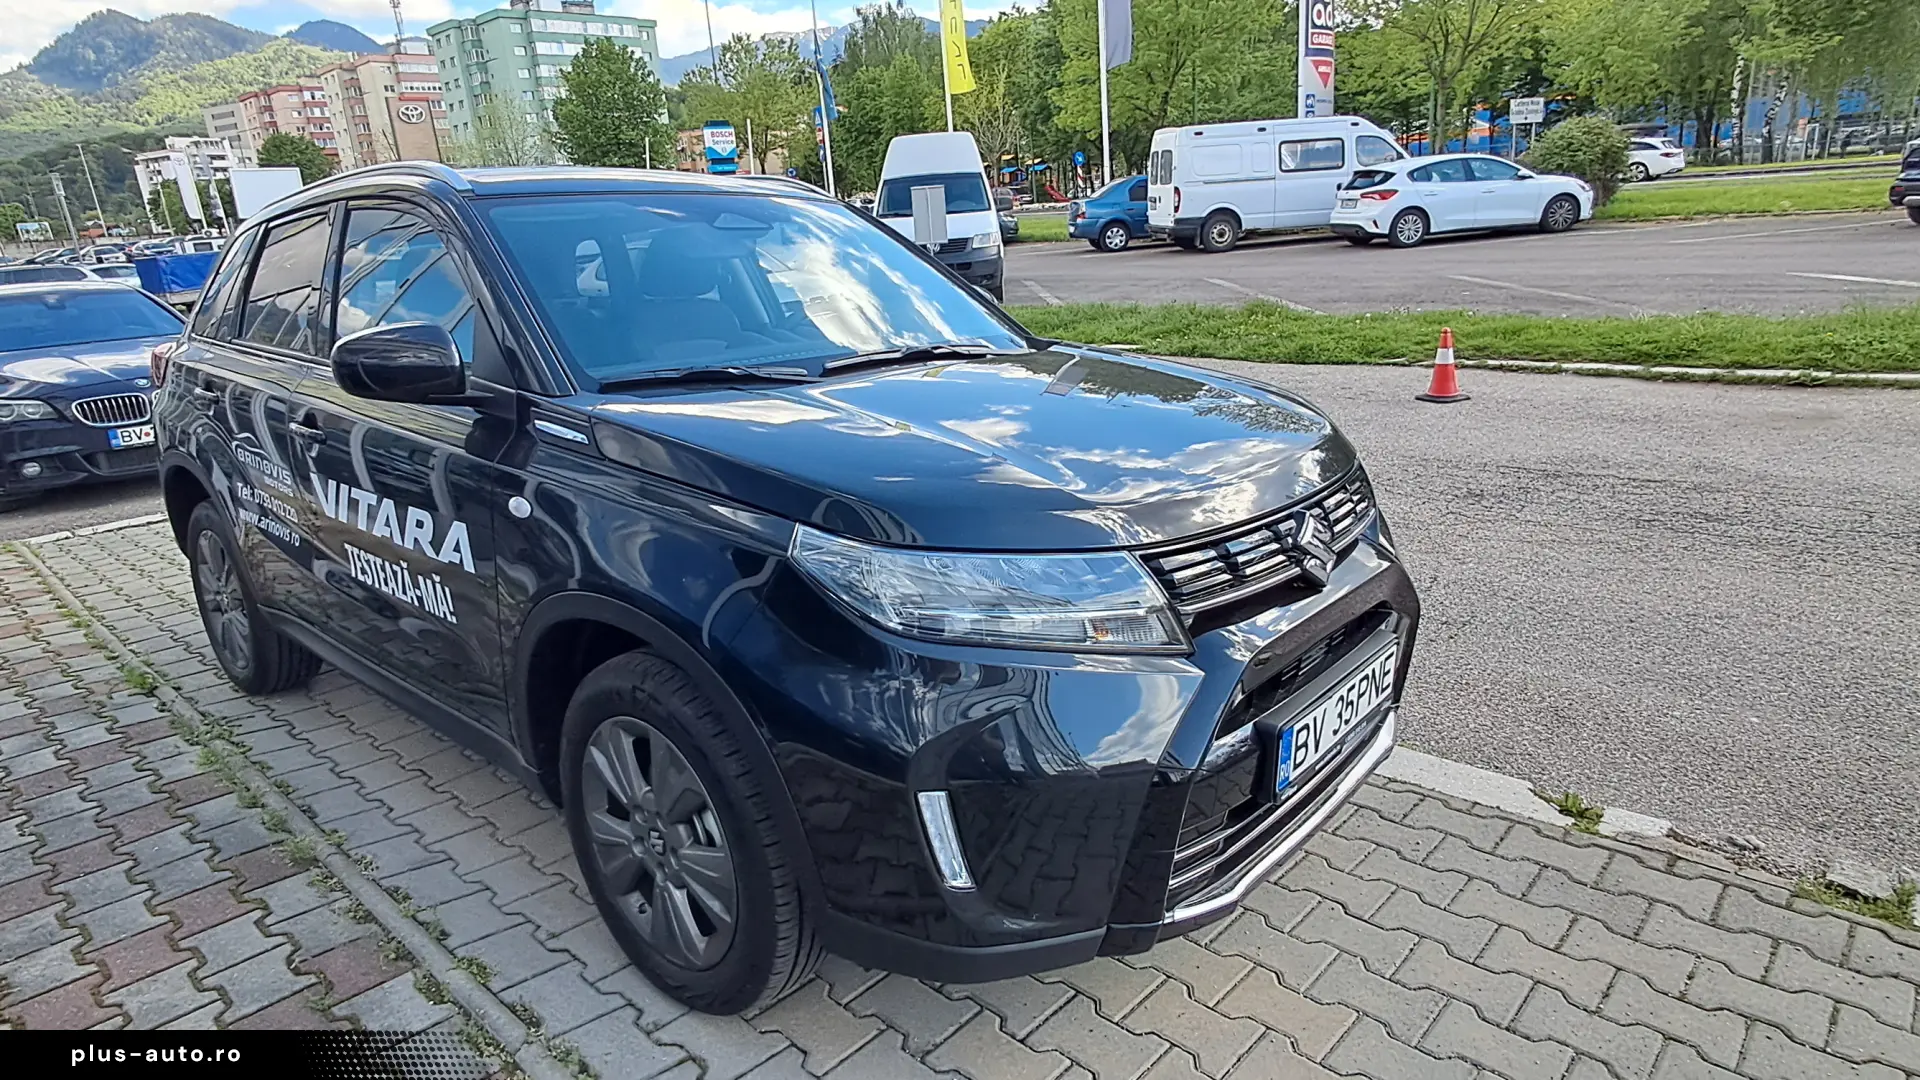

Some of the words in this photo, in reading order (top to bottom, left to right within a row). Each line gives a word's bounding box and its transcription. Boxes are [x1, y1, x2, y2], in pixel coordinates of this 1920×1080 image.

[120, 428, 142, 443] BV
[309, 472, 476, 574] VITARA
[344, 543, 458, 624] TESTEAZĂ-MĂ!
[1292, 707, 1328, 772] BV
[1332, 651, 1395, 737] 35PNE
